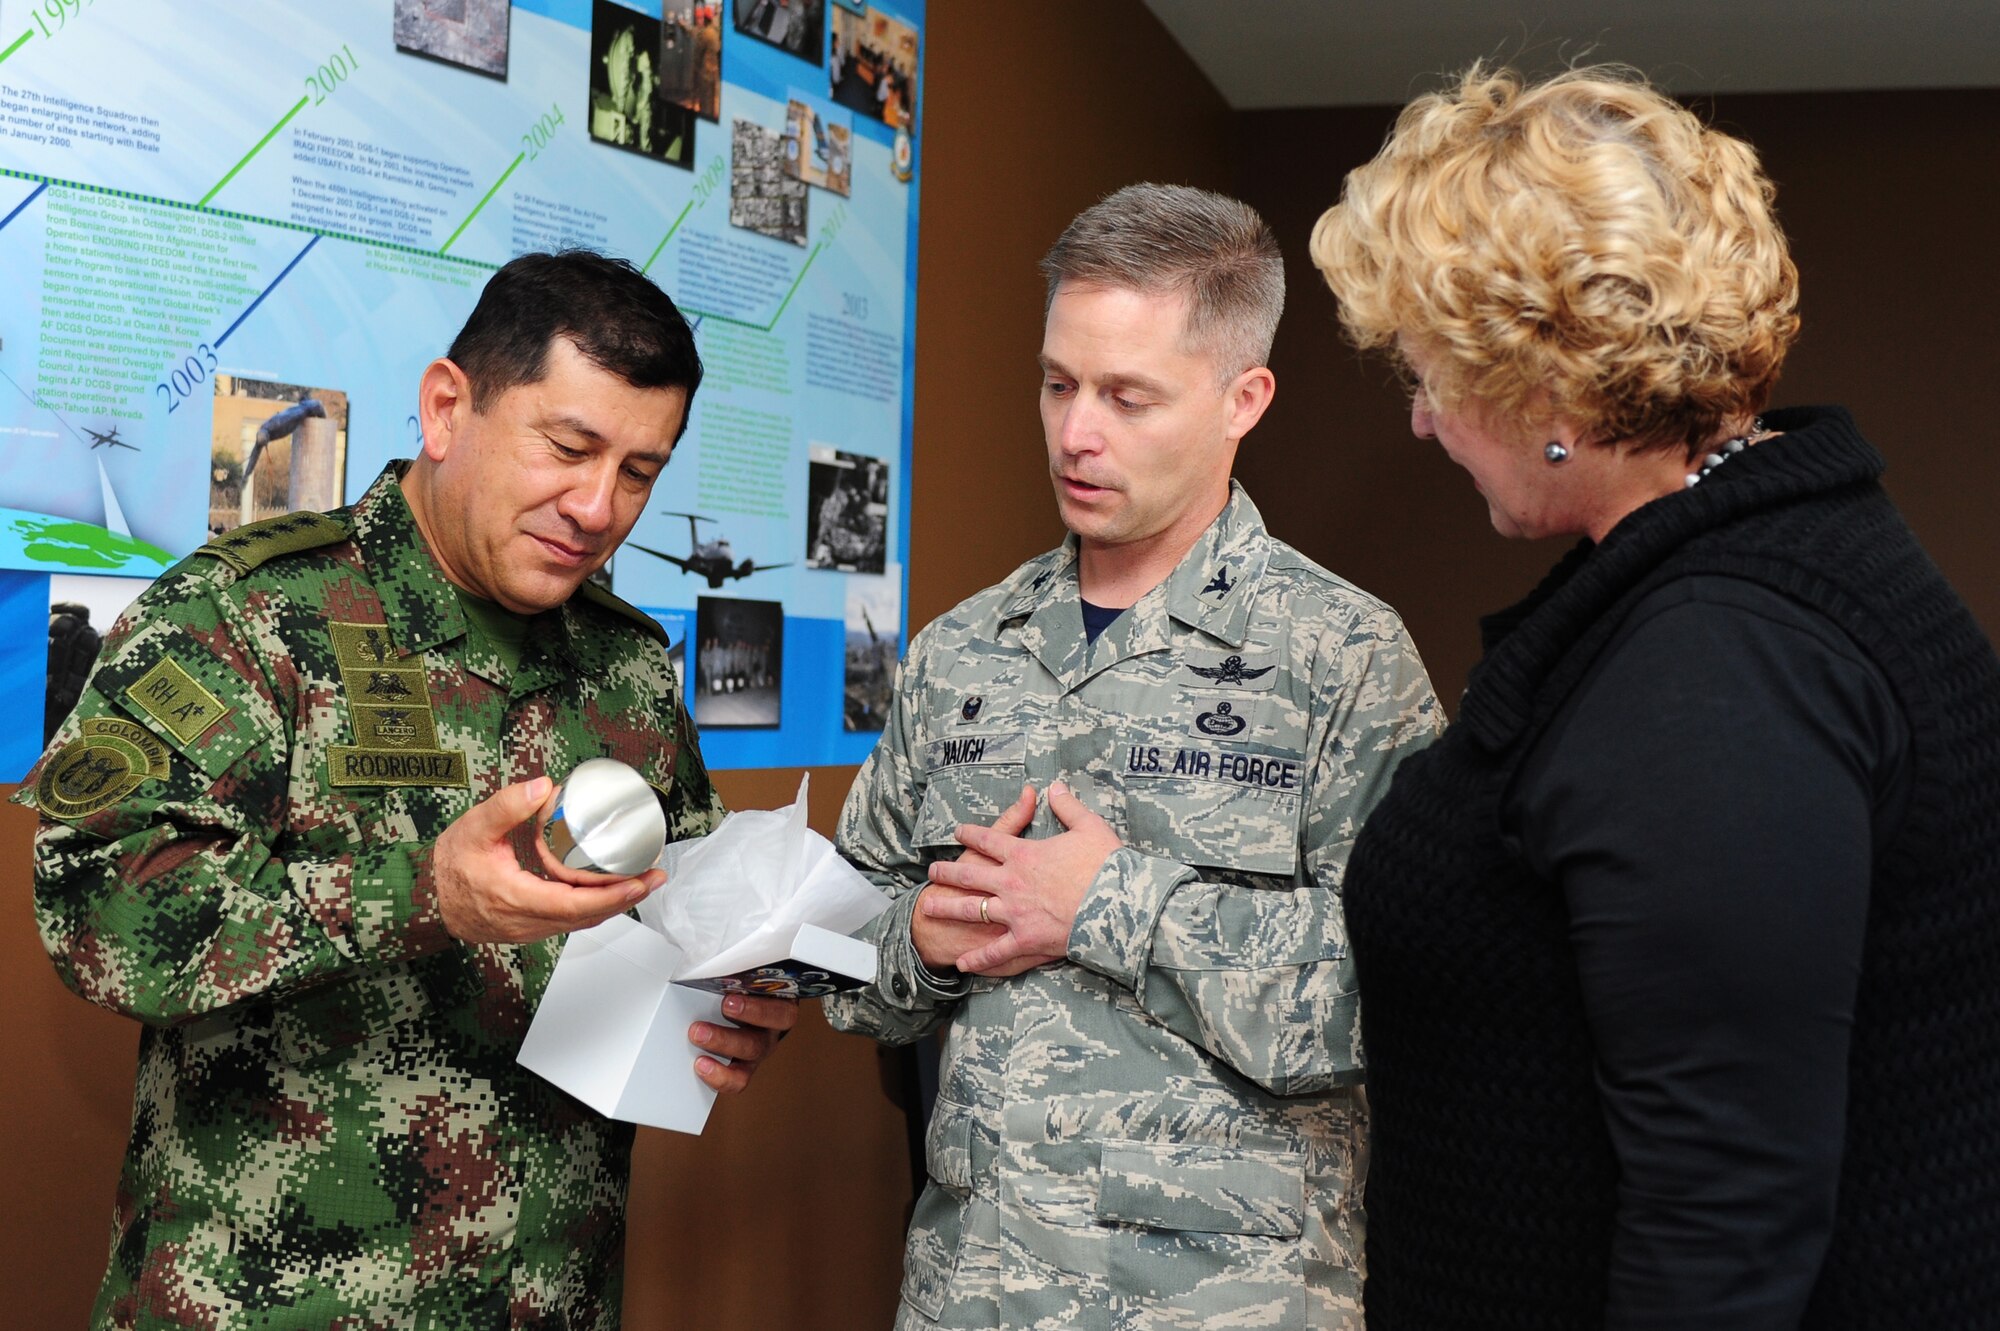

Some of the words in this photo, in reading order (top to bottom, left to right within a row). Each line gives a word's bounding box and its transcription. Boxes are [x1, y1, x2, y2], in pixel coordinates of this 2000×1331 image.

[31, 0, 94, 39] 199
[304, 44, 359, 107] 2001
[0, 99, 29, 113] began
[32, 107, 74, 123] enlarging
[76, 114, 90, 125] the
[131, 126, 160, 141] adding
[2, 86, 19, 97] The
[21, 90, 41, 102] 27th
[43, 94, 94, 113] Intelligence
[96, 106, 138, 122] Squadron
[140, 115, 159, 127] then
[0, 125, 8, 134] in
[10, 127, 47, 144] January
[8, 116, 43, 129] number
[46, 122, 54, 131] of
[57, 124, 78, 136] sites
[81, 129, 114, 145] starting
[116, 137, 134, 147] with
[136, 140, 160, 152] Beale
[521, 102, 565, 162] 2004
[156, 343, 218, 415] 2003
[145, 676, 180, 706] RH
[95, 722, 164, 767] COLOMBIA
[942, 738, 985, 766] HAUGH
[345, 754, 452, 778] RODRIGUEZ
[1129, 747, 1163, 772] U.S.
[1172, 749, 1211, 777] AIR
[1218, 753, 1296, 788] FORCE
